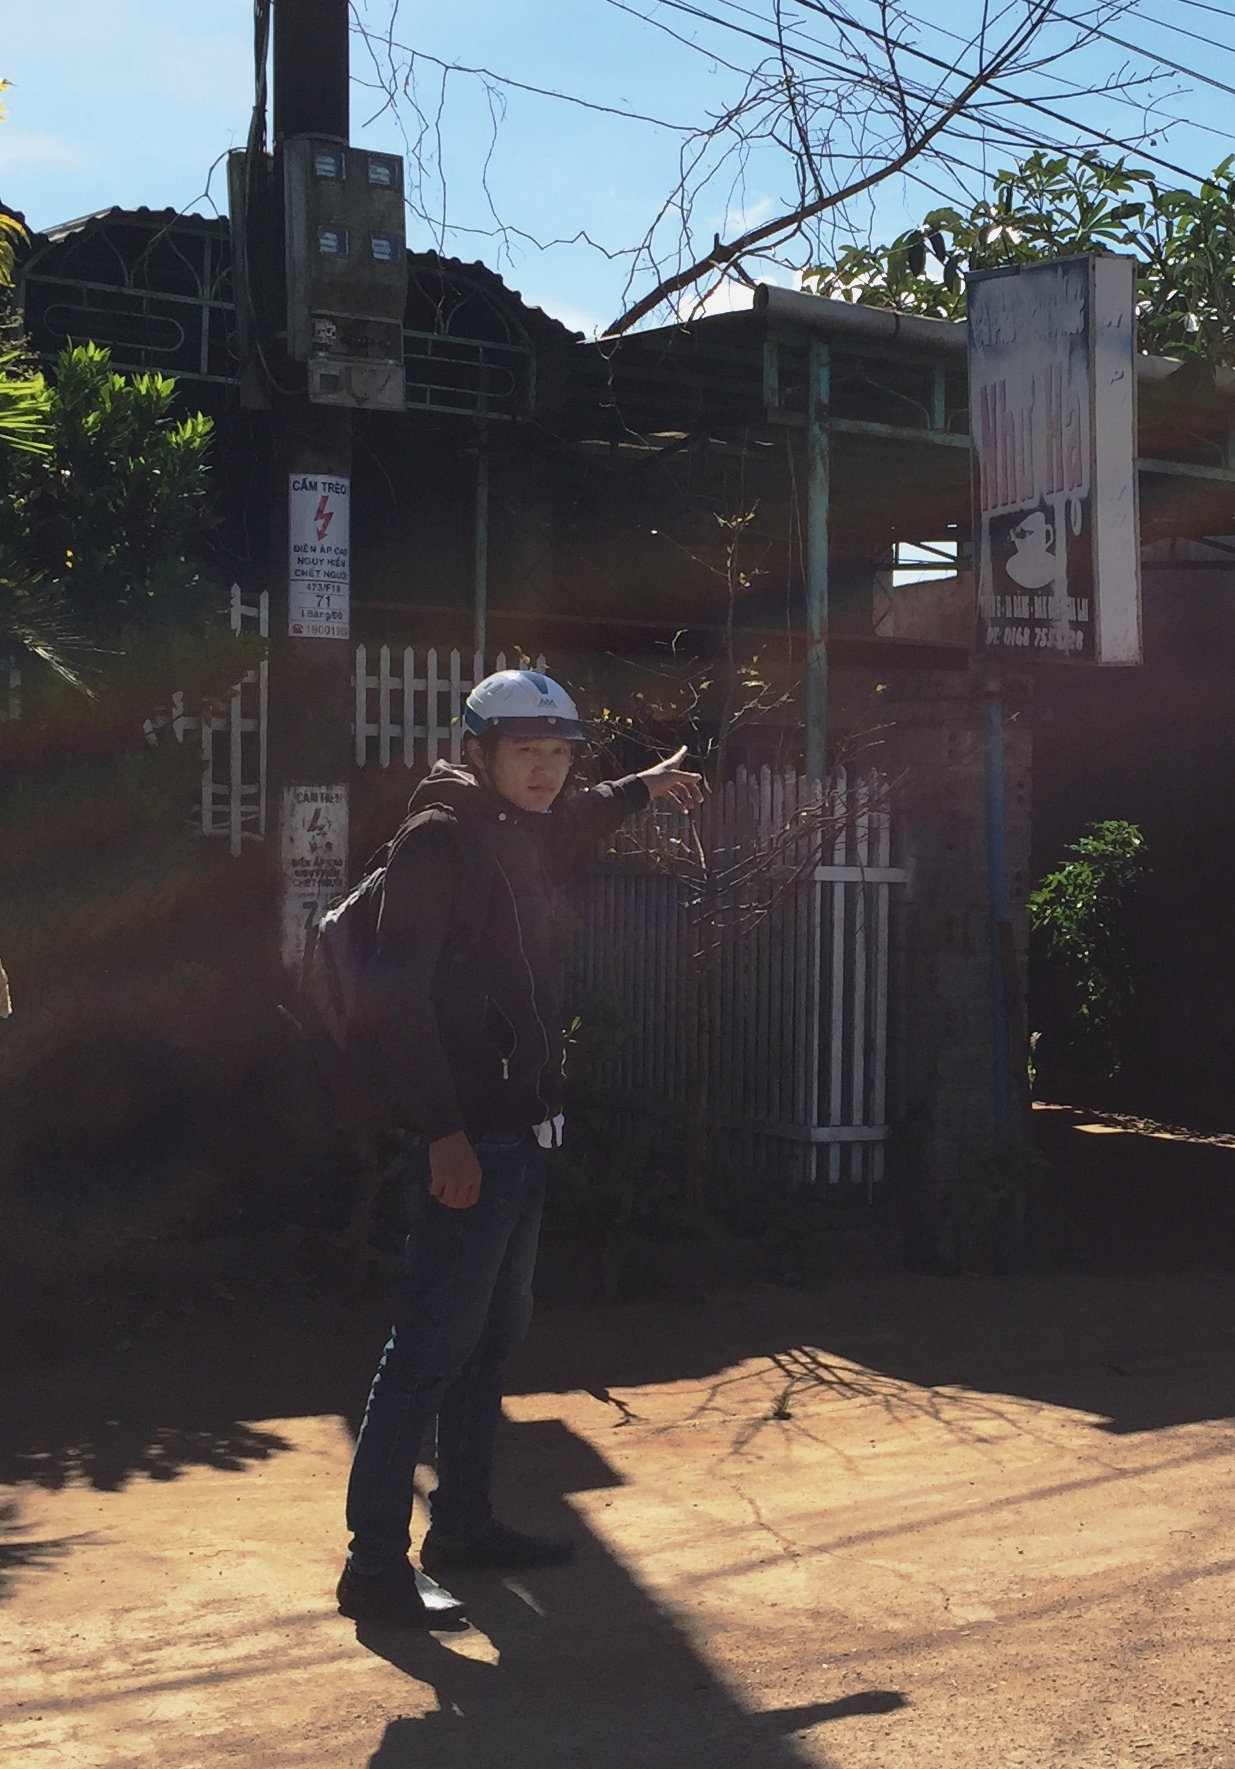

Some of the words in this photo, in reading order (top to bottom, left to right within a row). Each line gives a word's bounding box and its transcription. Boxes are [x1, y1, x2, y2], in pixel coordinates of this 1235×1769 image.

[293, 477, 318, 492] CẤM
[321, 481, 347, 495] TRÈO
[297, 557, 325, 566] NGUY
[316, 594, 331, 607] 71
